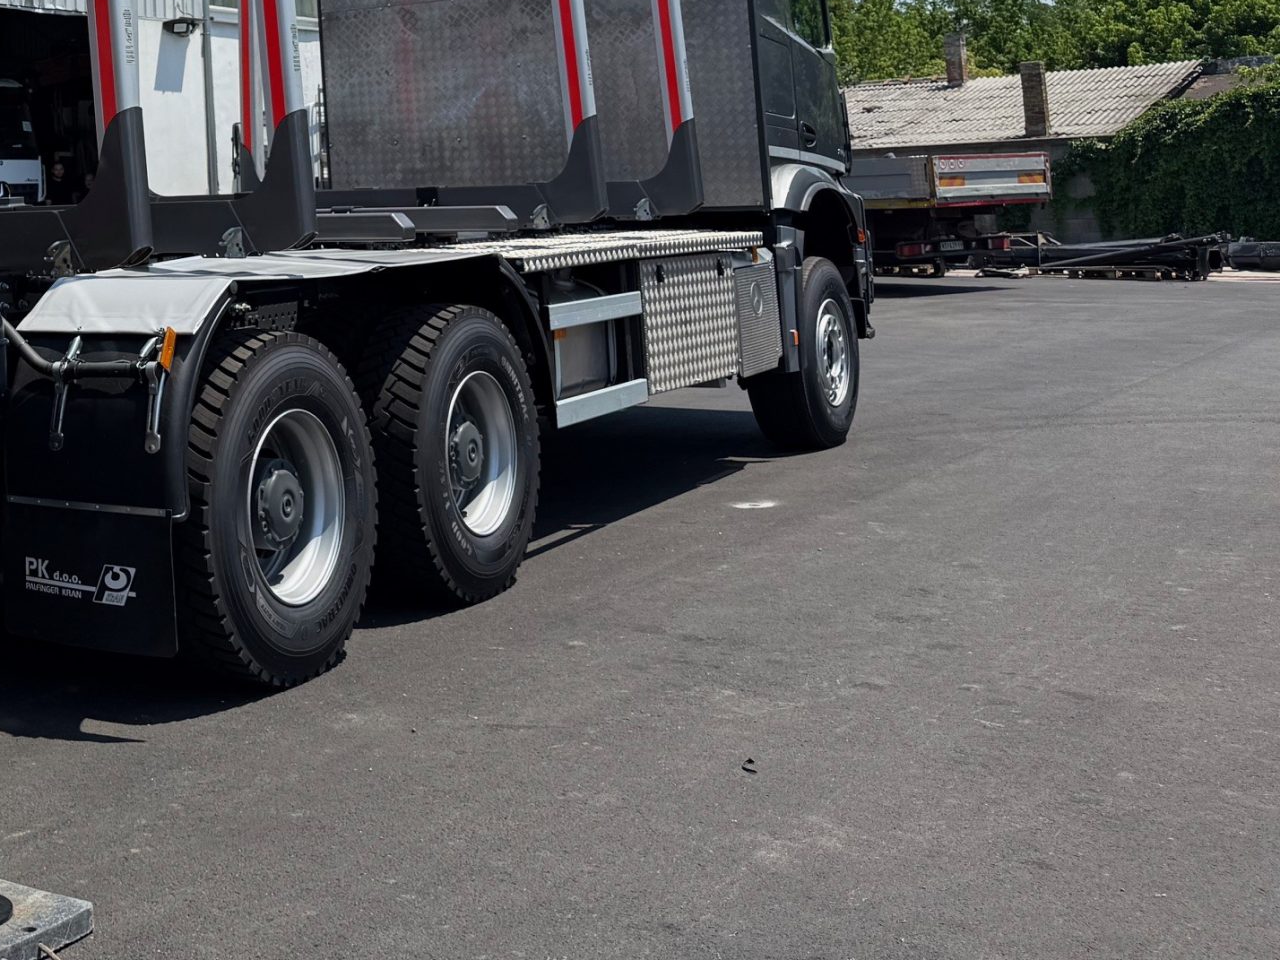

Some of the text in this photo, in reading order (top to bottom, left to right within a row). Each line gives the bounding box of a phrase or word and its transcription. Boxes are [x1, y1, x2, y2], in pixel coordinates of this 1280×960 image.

[25, 556, 82, 585] PK d.o.o.
[25, 582, 82, 599] PALFINGER KRAN
